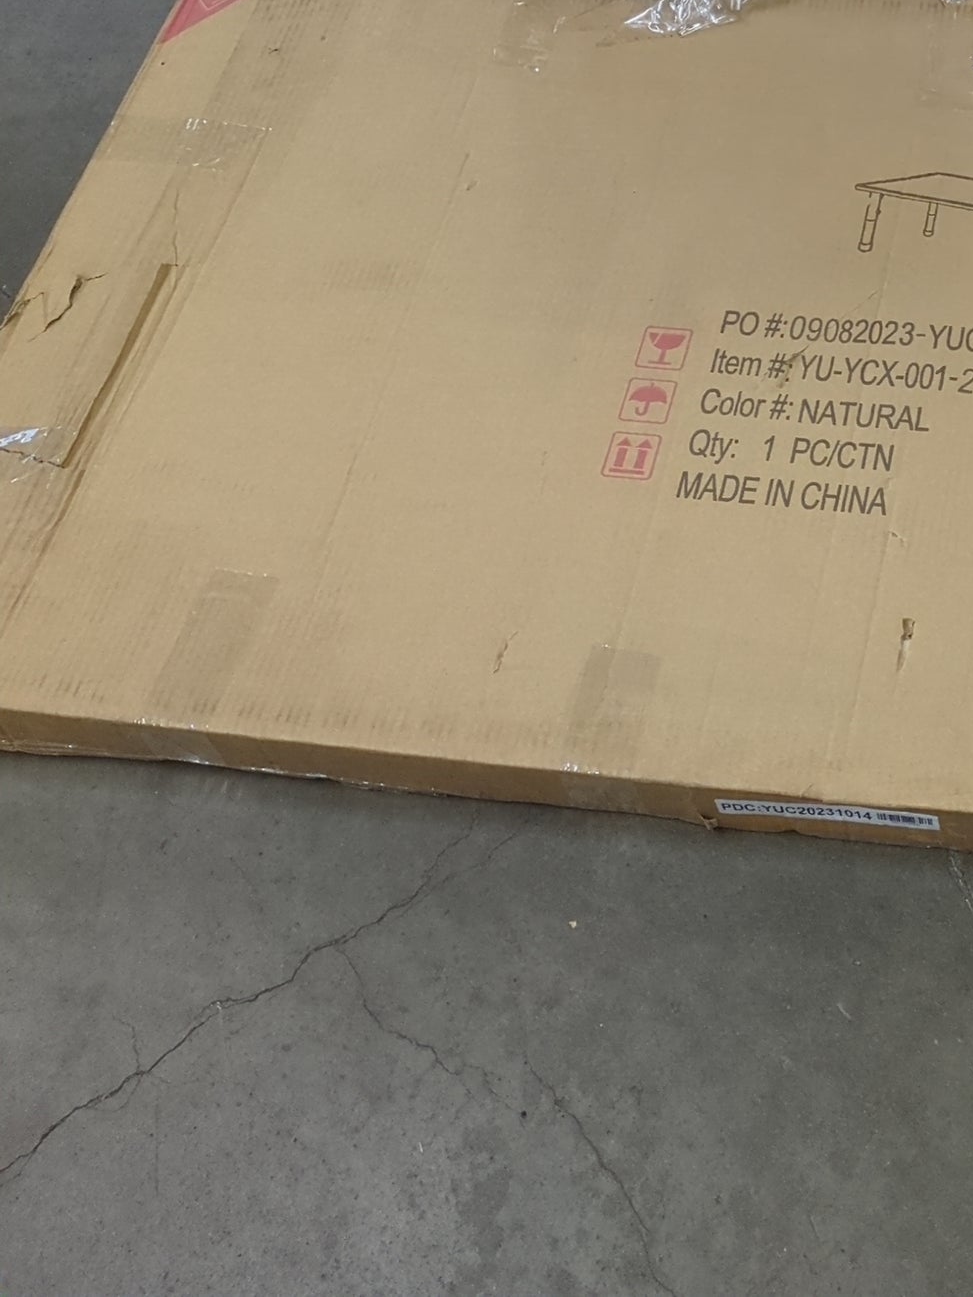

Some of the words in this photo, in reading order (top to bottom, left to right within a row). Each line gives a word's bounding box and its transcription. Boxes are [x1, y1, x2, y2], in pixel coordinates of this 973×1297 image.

[720, 310, 760, 336] PO
[710, 348, 762, 376] Item
[700, 388, 766, 418] Color
[688, 428, 739, 465] Qty:
[763, 435, 776, 462] 1
[790, 437, 895, 472] PC/CTN
[676, 470, 760, 505] MADE
[764, 478, 795, 508] IN
[800, 481, 888, 516] CHINA
